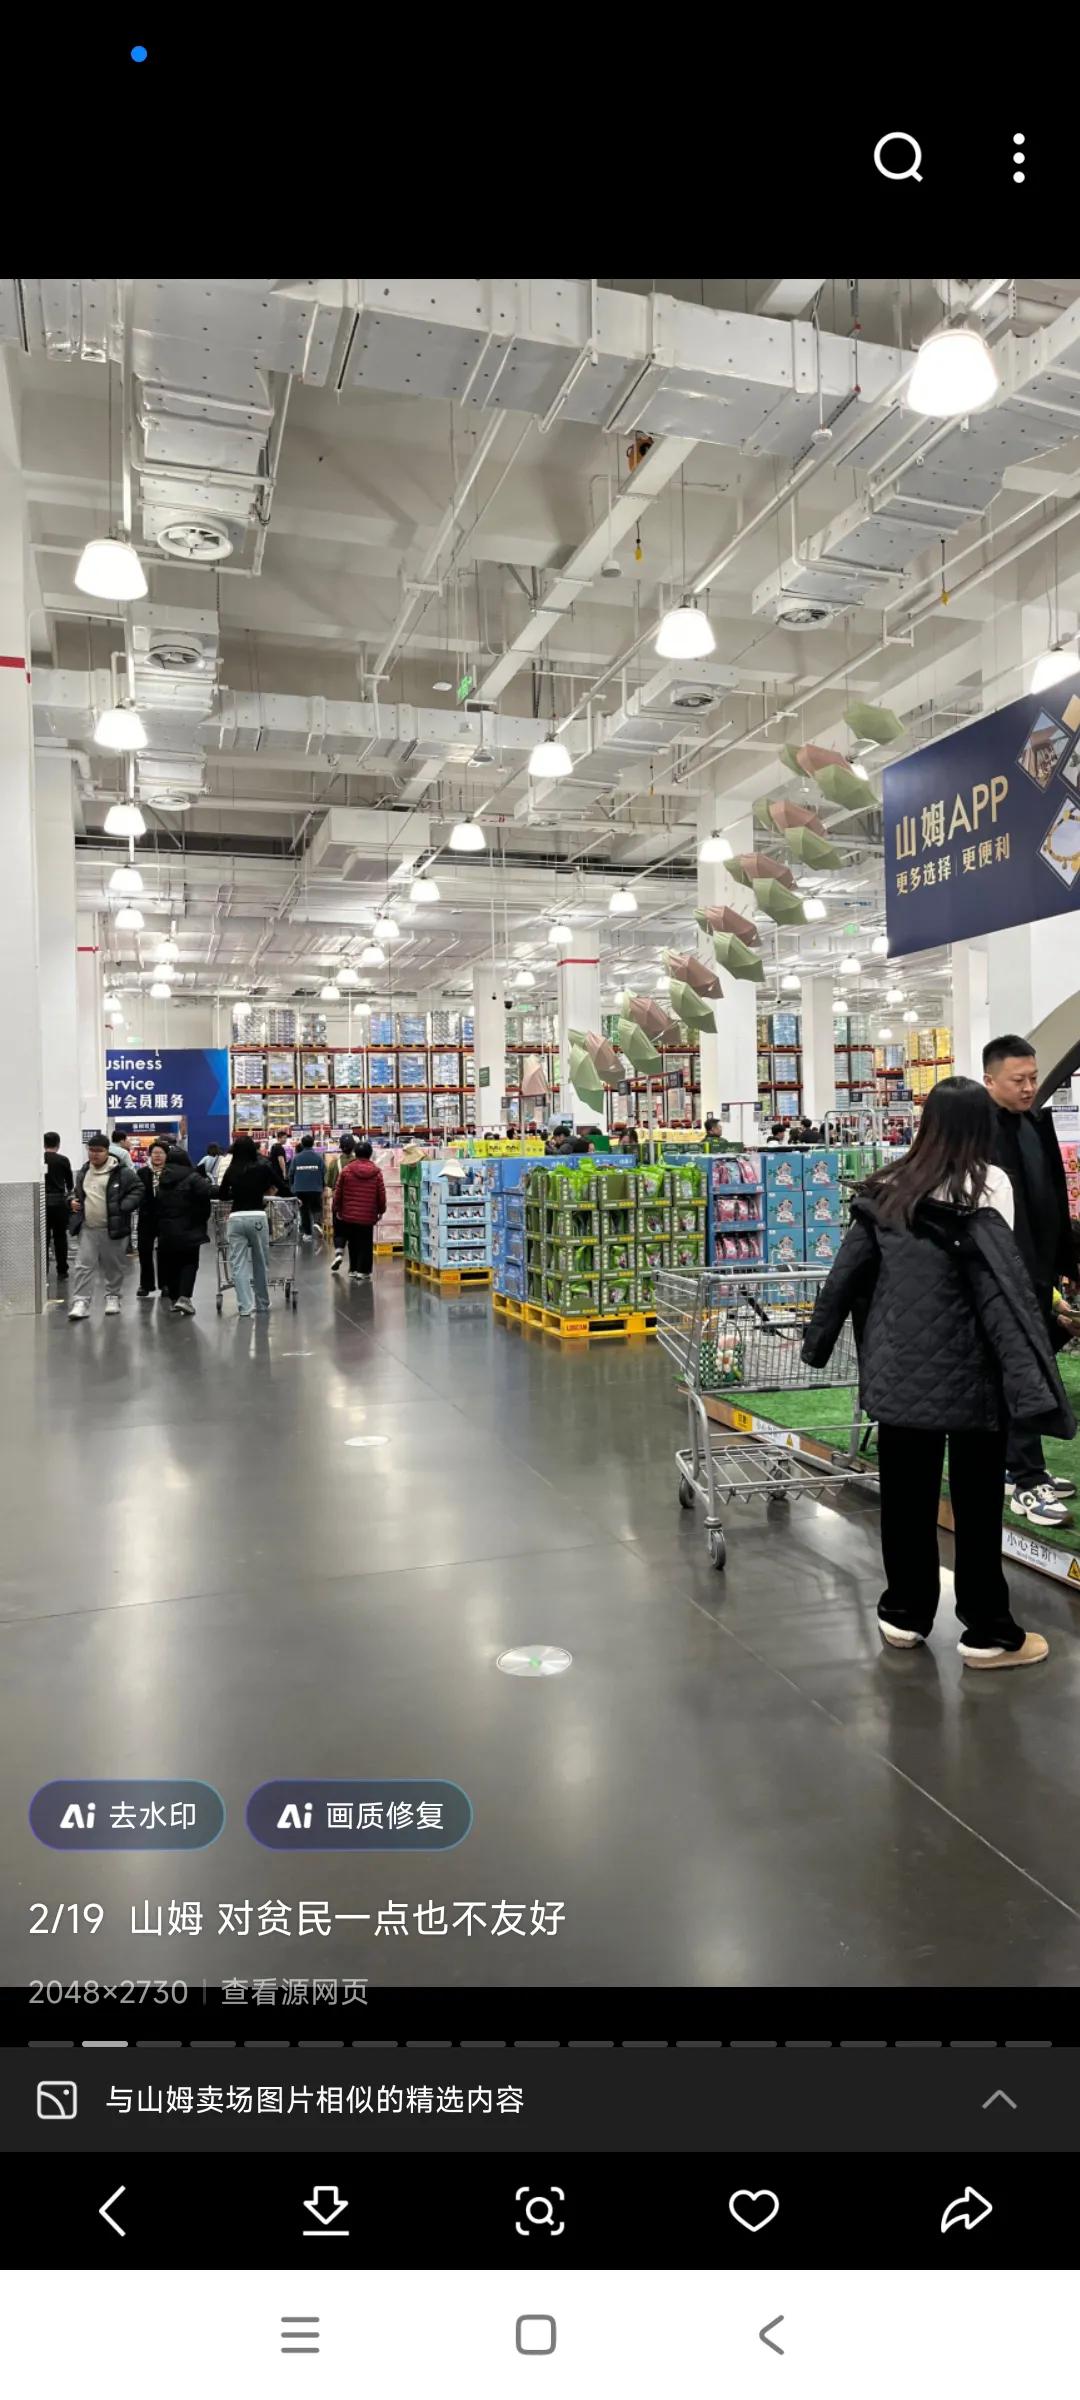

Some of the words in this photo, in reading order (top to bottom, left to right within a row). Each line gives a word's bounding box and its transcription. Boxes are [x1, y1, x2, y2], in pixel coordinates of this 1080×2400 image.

[895, 775, 1009, 860] 山姆APP
[896, 855, 951, 896] 更多选择
[962, 832, 1011, 874] 更便利
